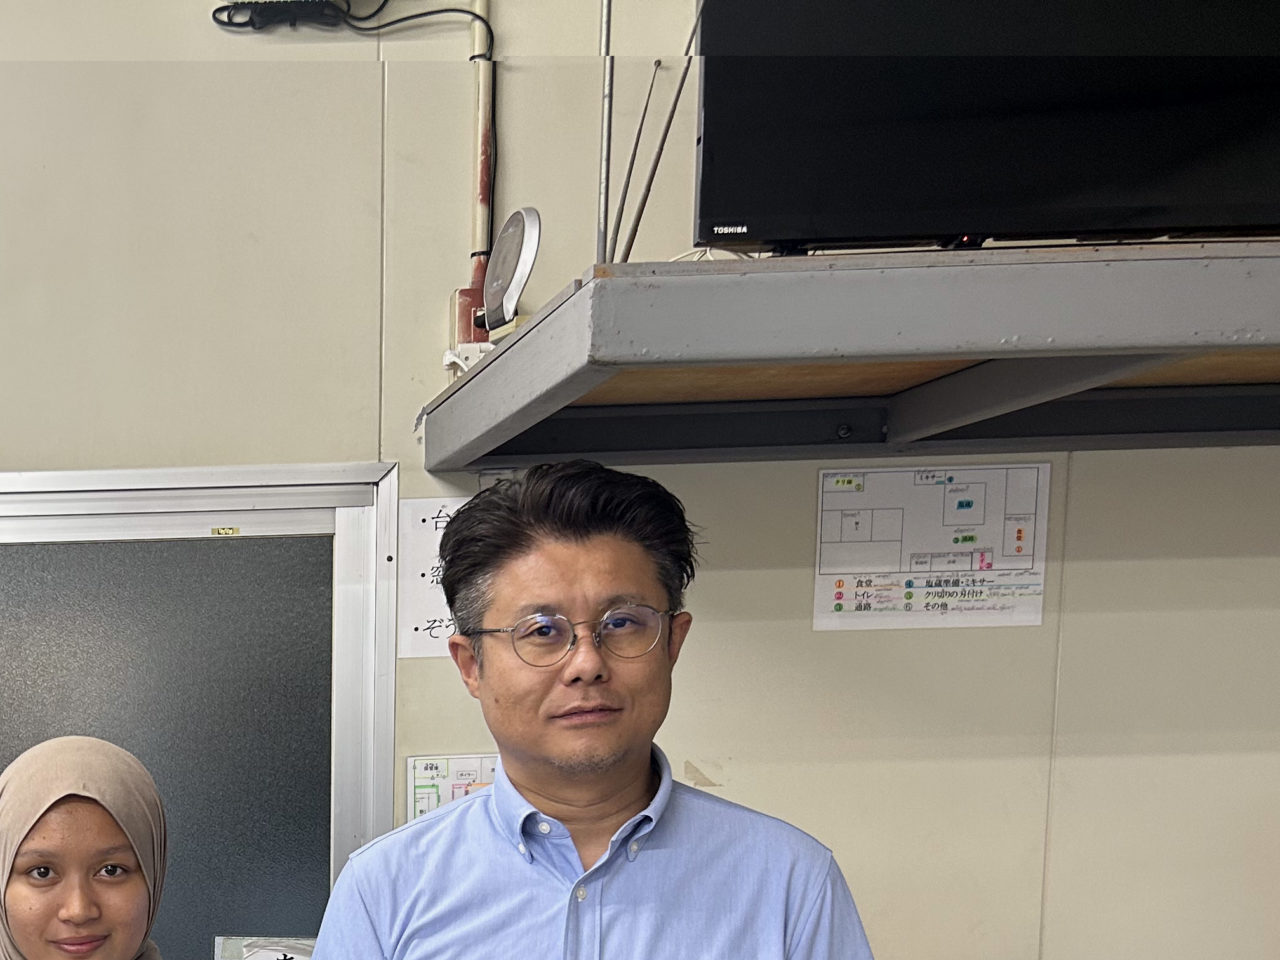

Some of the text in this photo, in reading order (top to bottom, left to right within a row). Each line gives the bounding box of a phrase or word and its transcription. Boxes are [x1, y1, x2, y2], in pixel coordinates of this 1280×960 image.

[713, 226, 748, 234] TOSHIBA
[855, 579, 873, 588] 食堂
[854, 591, 874, 599] トイレ
[854, 602, 872, 612] 通路
[924, 602, 949, 612] その他
